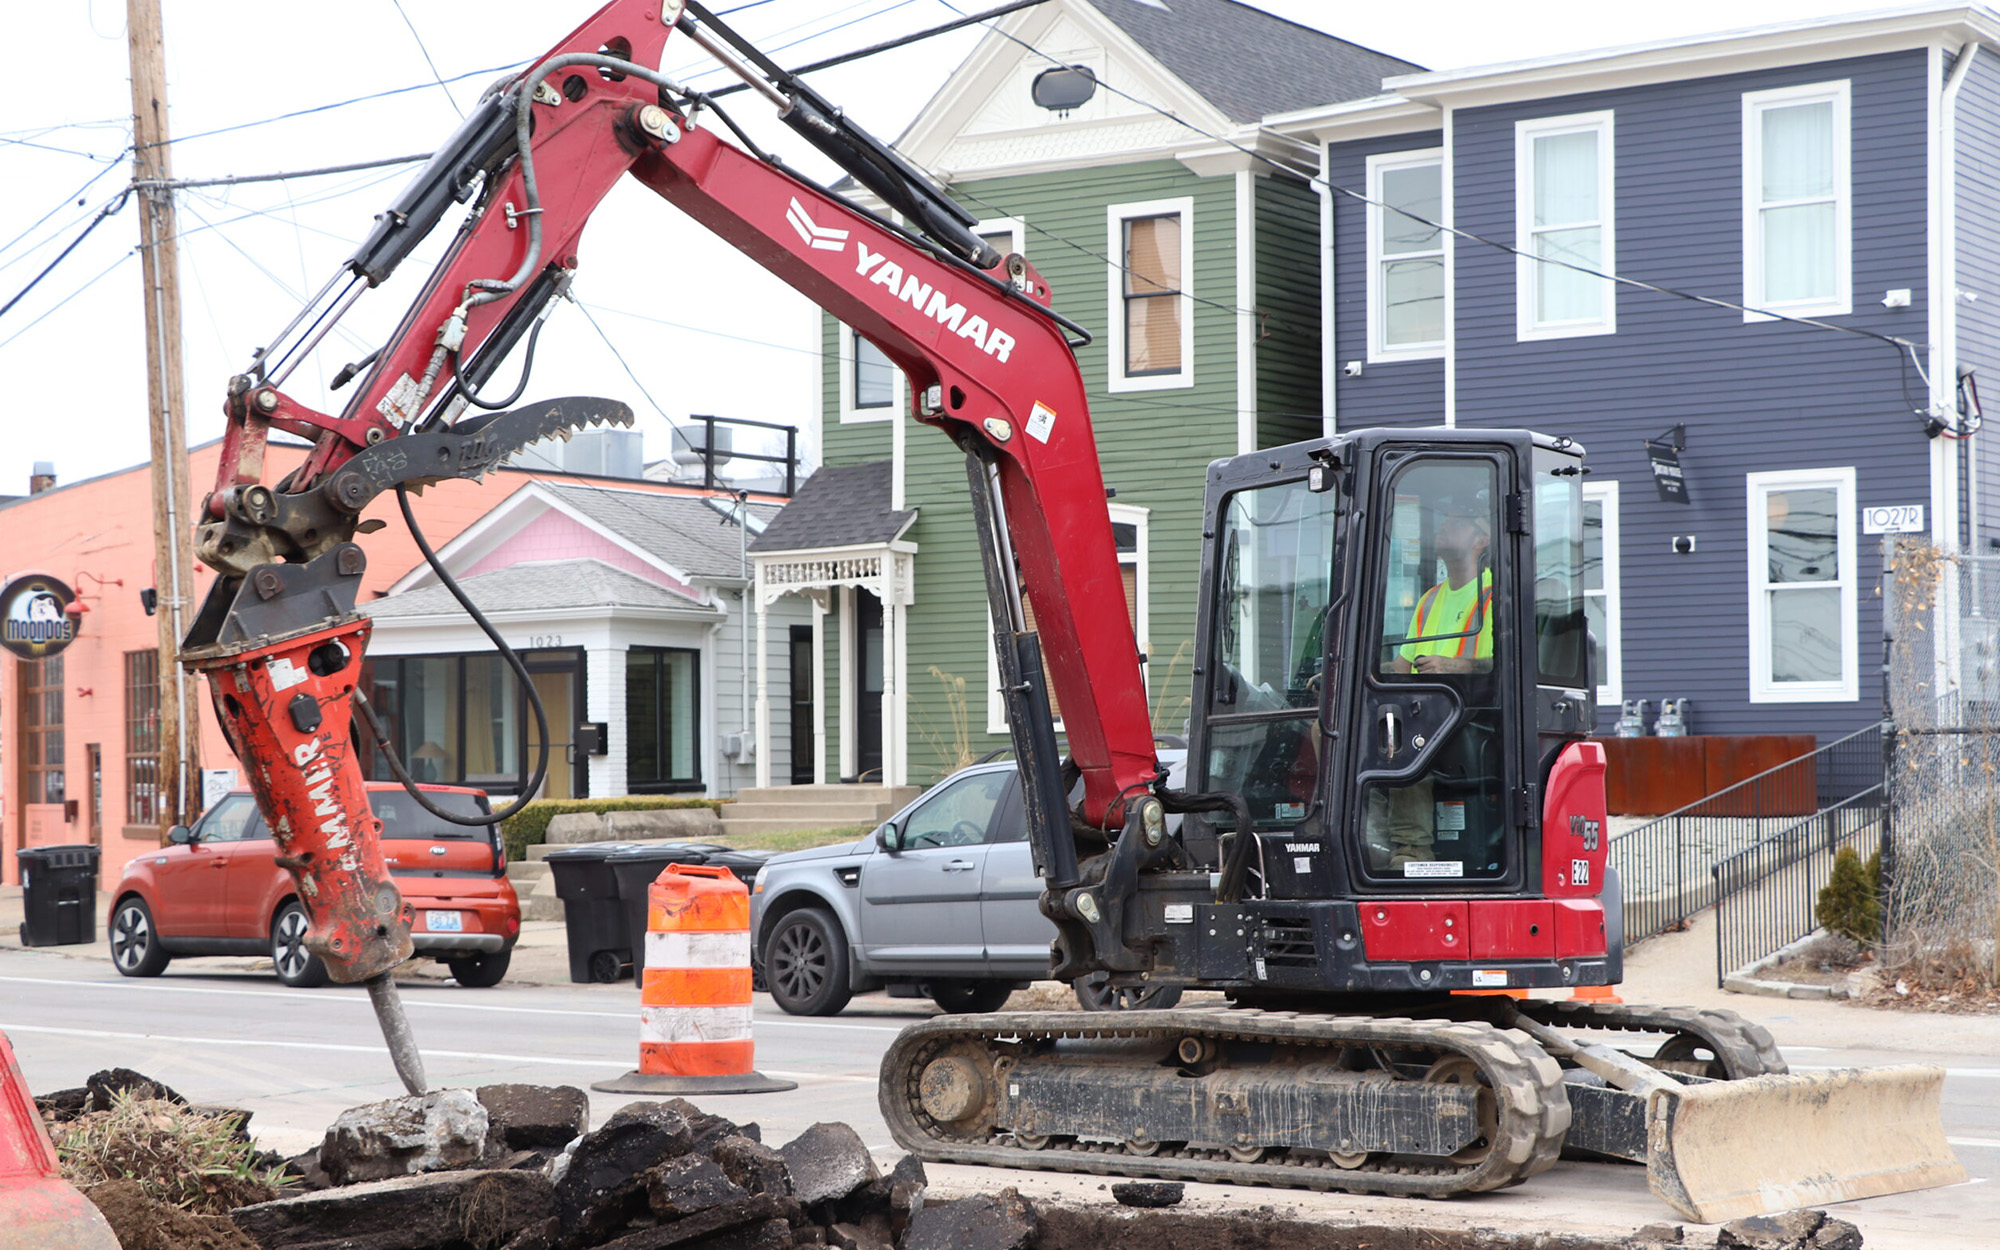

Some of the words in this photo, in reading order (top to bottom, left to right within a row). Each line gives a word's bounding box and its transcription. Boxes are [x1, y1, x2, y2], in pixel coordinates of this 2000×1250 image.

[855, 241, 1016, 364] YANMAR
[1868, 507, 1919, 526] 1027R
[530, 635, 562, 649] 1023
[1285, 843, 1320, 853] YANMAR
[1572, 861, 1588, 884] E22
